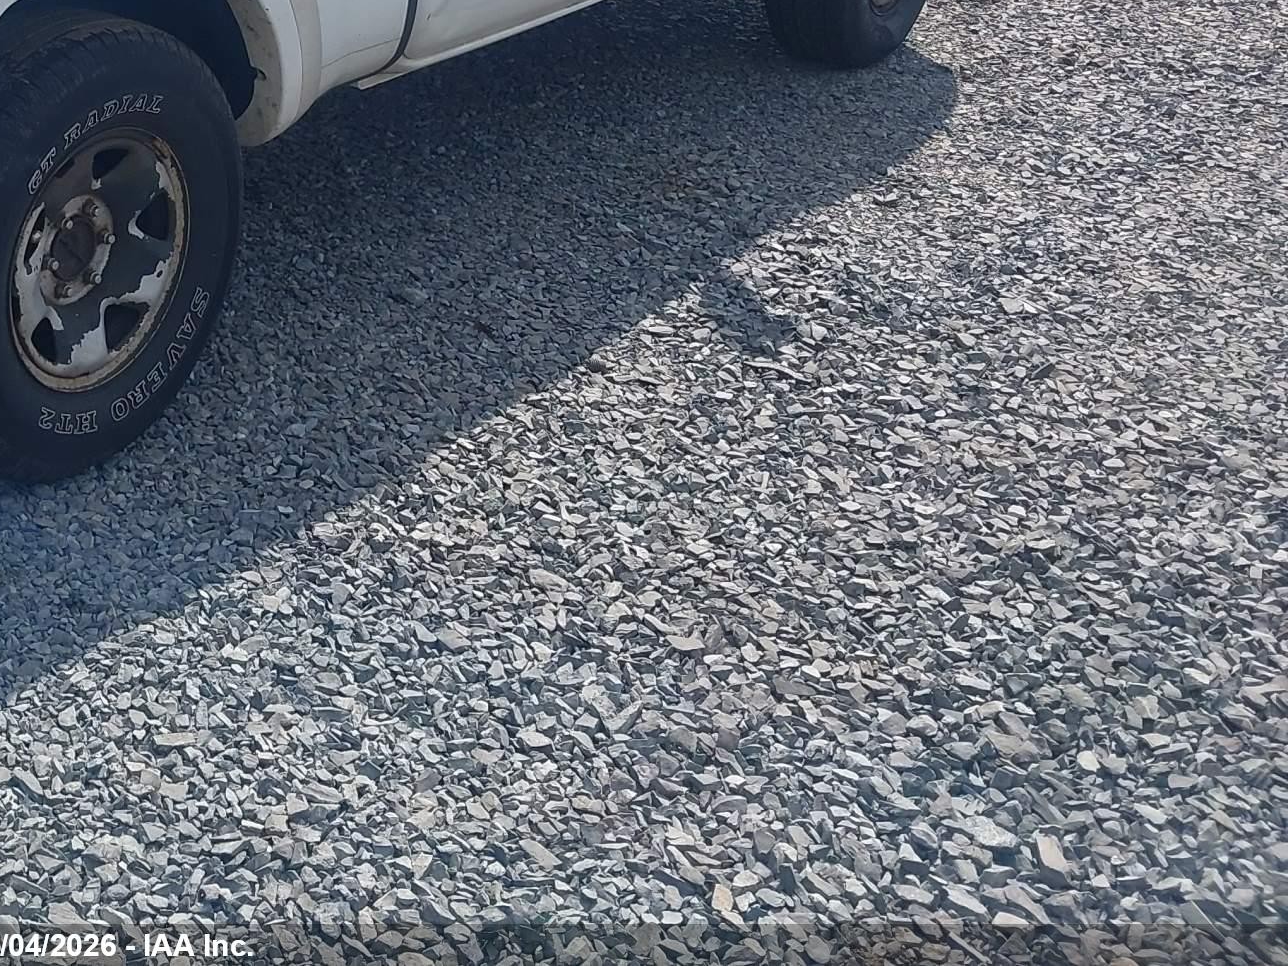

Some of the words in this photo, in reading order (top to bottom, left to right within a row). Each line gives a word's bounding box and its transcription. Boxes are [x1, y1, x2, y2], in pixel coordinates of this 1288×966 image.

[27, 147, 56, 195] GT
[63, 94, 164, 150] RADIAL
[111, 286, 211, 421] SAVERO
[38, 406, 98, 435] HT2
